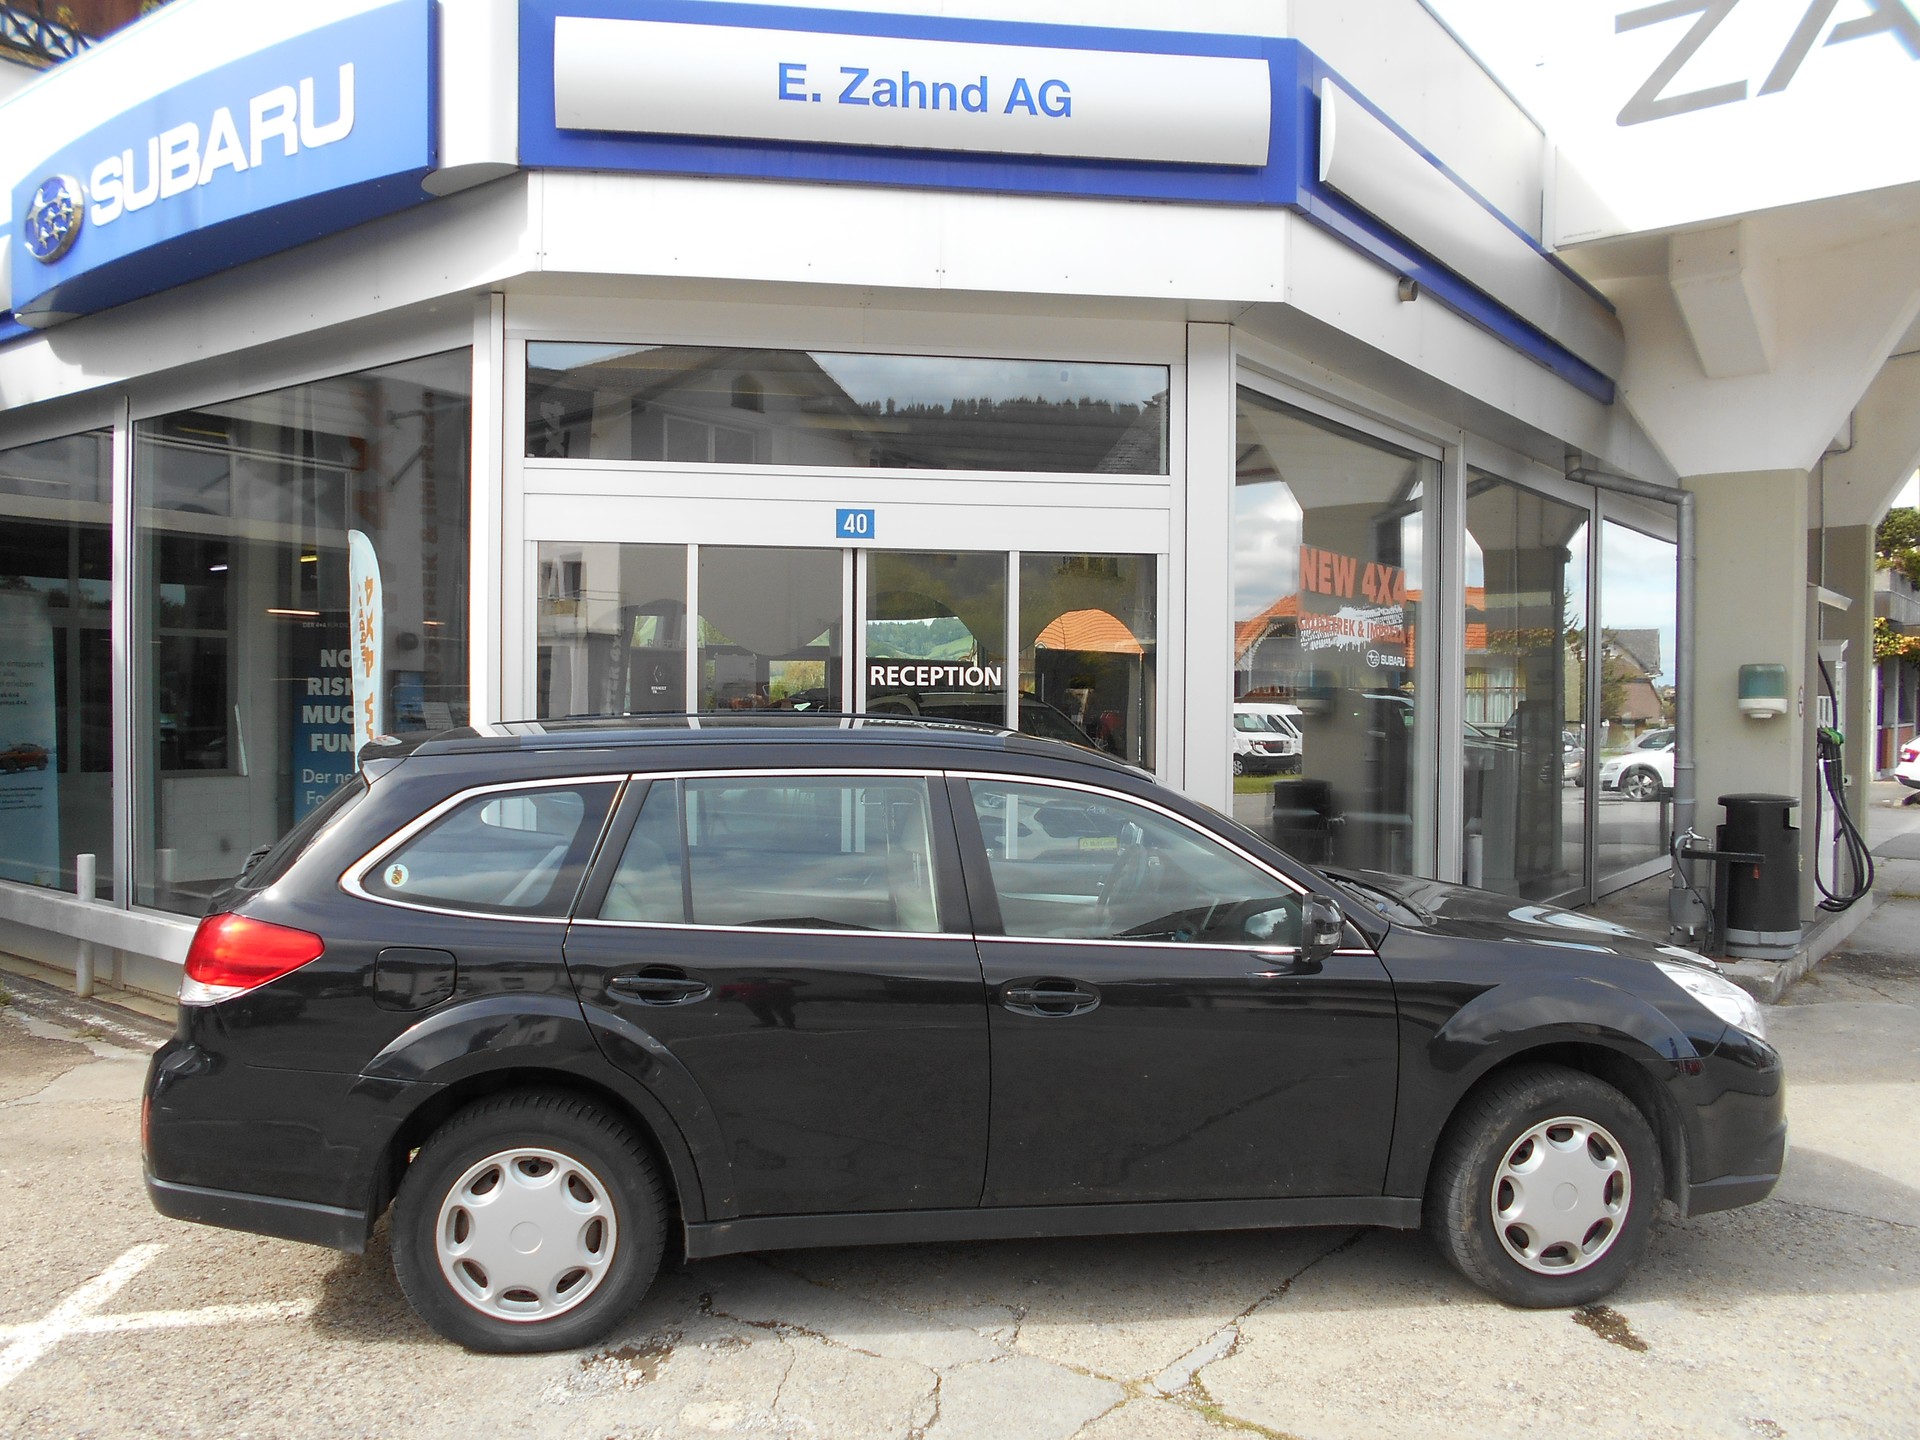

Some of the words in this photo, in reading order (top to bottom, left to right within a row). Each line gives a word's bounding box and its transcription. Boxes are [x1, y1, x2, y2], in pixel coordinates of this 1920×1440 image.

[778, 62, 822, 103] E.
[838, 66, 988, 113] Zahnd
[1003, 77, 1072, 118] AG
[86, 62, 355, 227] SUBARU
[843, 513, 868, 534] 40
[1299, 545, 1357, 599] NEW
[1361, 561, 1406, 608] 4X4
[1380, 654, 1406, 667] SUBARU
[870, 665, 1002, 687] RECEPTION
[311, 733, 355, 752] FUN
[303, 769, 331, 783] Der
